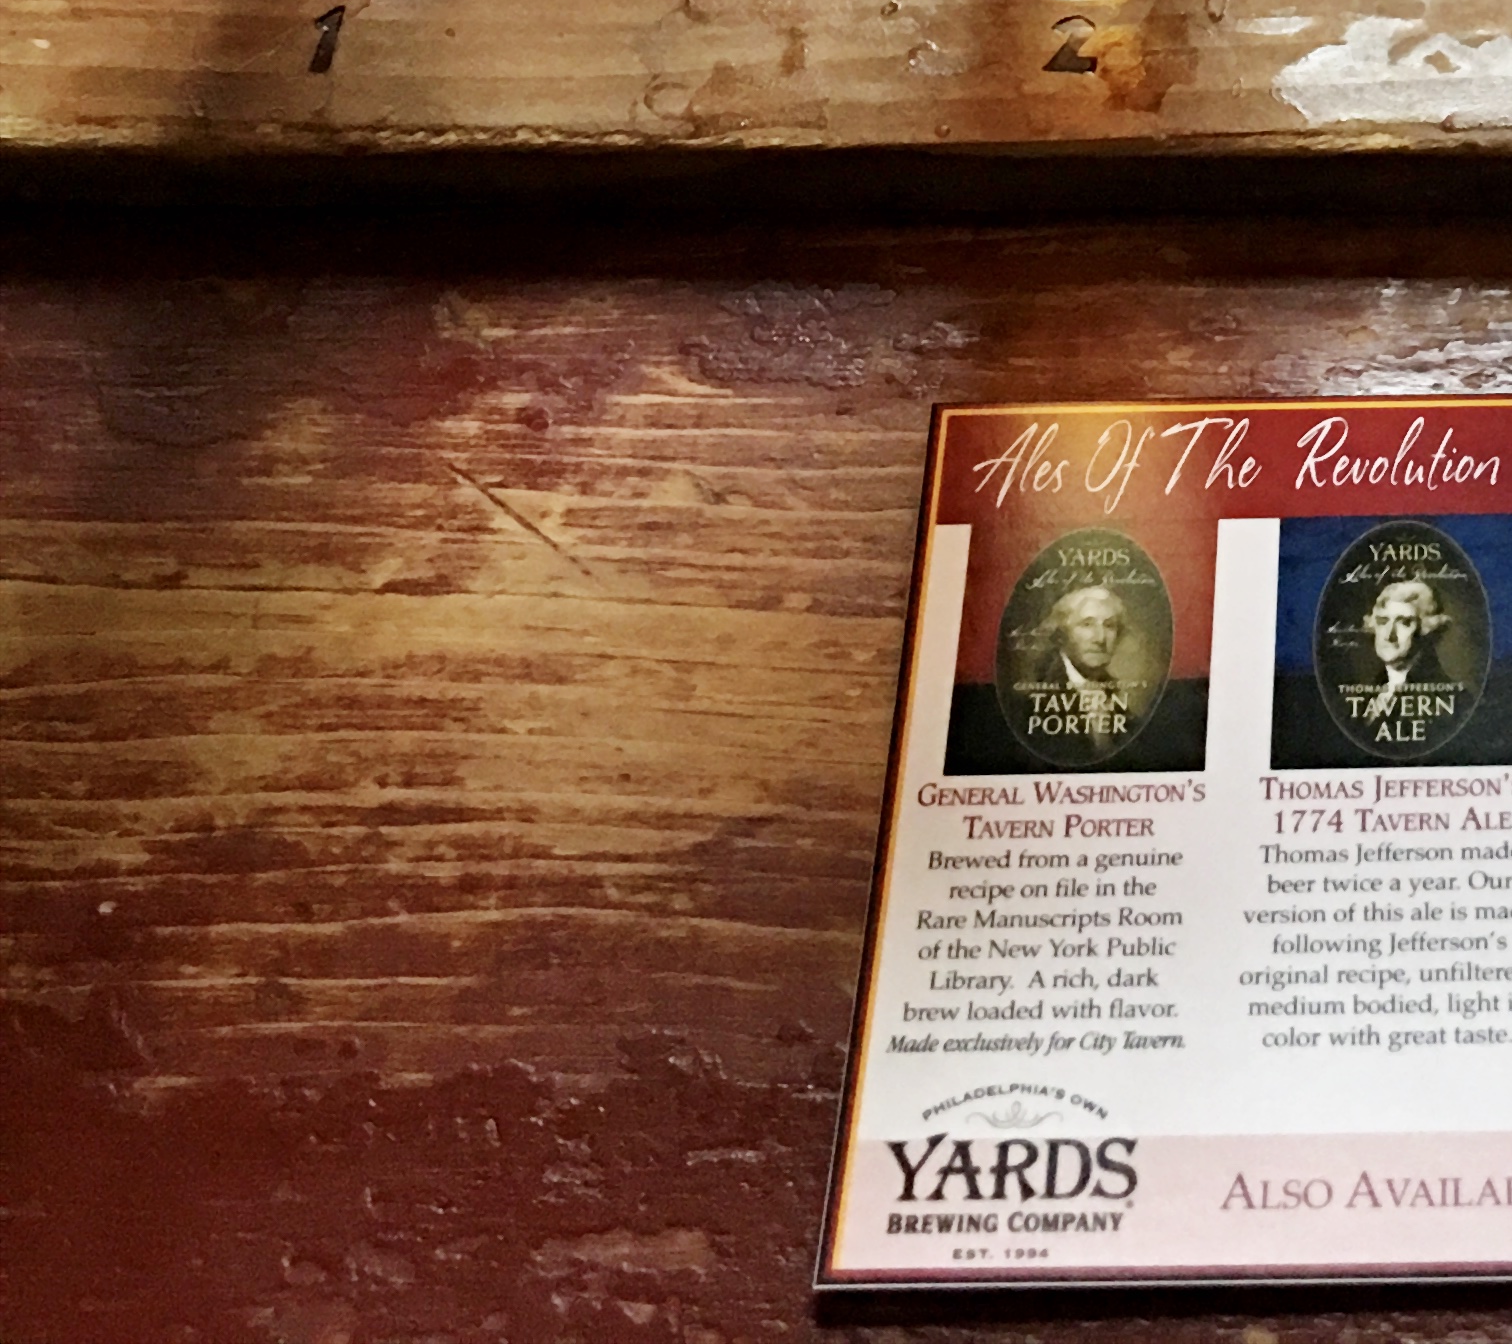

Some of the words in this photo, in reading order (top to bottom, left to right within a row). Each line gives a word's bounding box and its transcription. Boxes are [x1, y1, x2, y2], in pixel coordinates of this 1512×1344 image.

[308, 5, 346, 75] 1
[1043, 15, 1097, 73] 2
[973, 423, 1069, 509] Ales
[1084, 419, 1155, 514] Of
[1161, 417, 1262, 496] The
[1294, 416, 1501, 491] Revolution
[1058, 548, 1130, 567] YARDS
[1369, 542, 1441, 561] YARDS
[1029, 690, 1128, 712] TAVERN
[1345, 695, 1455, 718] TAVERN
[1028, 714, 1127, 735] PORTER
[1374, 720, 1426, 742] ALE
[918, 782, 1024, 807] GENERAL
[1033, 779, 1206, 805] WASHINGTON'S
[1259, 776, 1363, 800] THOMAS
[964, 816, 1054, 839] TAVERN
[1064, 814, 1154, 838] PORTER
[1274, 810, 1344, 833] 1774
[1355, 809, 1450, 832] TAVERN
[1460, 807, 1512, 831] ALE
[928, 850, 1010, 870] Brewed
[1018, 849, 1069, 868] from
[1077, 852, 1088, 867] a
[1094, 848, 1183, 872] genuine
[1259, 844, 1349, 864] Thomas
[1355, 842, 1452, 866] Jefferson
[949, 880, 1015, 904] recipe
[1020, 884, 1048, 898] on
[1055, 879, 1089, 897] file
[1096, 879, 1116, 897] in
[1124, 876, 1157, 896] the
[1268, 874, 1315, 893] beer
[1324, 873, 1382, 892] twice
[1389, 877, 1401, 891] a
[1408, 877, 1460, 897] year.
[917, 911, 966, 930] Rare
[974, 909, 1110, 933] Manuscripts
[1118, 908, 1182, 927] Room
[1243, 904, 1326, 923] version
[1333, 904, 1357, 923] of
[1363, 902, 1404, 921] this
[1411, 902, 1443, 921] ale
[1450, 902, 1468, 920] is
[918, 940, 942, 960] of
[947, 940, 981, 960] the
[989, 940, 1040, 958] New
[1050, 938, 1098, 958] York
[1108, 937, 1176, 957] Public
[1273, 934, 1382, 959] following
[1389, 930, 1507, 955] Jefferson's
[929, 970, 1015, 995] Library.
[1027, 970, 1046, 988] A
[1053, 968, 1099, 990] rich,
[1108, 968, 1158, 987] dark
[1239, 964, 1328, 992] original
[1337, 964, 1411, 988] recipe,
[903, 1002, 959, 1021] brew
[968, 1001, 1043, 1021] loaded
[1052, 999, 1101, 1019] with
[1109, 999, 1179, 1018] flavor.
[1248, 996, 1344, 1016] medium
[1353, 994, 1438, 1016] bodied,
[1449, 991, 1500, 1019] light
[887, 1035, 939, 1053] Made
[943, 1032, 1043, 1056] exclusively
[1044, 1031, 1076, 1056] for
[1079, 1032, 1117, 1055] City
[1123, 1030, 1185, 1050] Tavern.
[1262, 1027, 1320, 1048] color
[1329, 1026, 1380, 1046] with
[1388, 1027, 1446, 1052] great
[1454, 1026, 1512, 1043] taste.
[922, 1083, 1066, 1120] PHILADELPHIA'S
[1070, 1094, 1108, 1120] OWN
[885, 1132, 1139, 1202] YARDS
[1220, 1173, 1334, 1210] ALSO
[887, 1213, 998, 1234] BREWING
[1008, 1211, 1125, 1232] COMPANY
